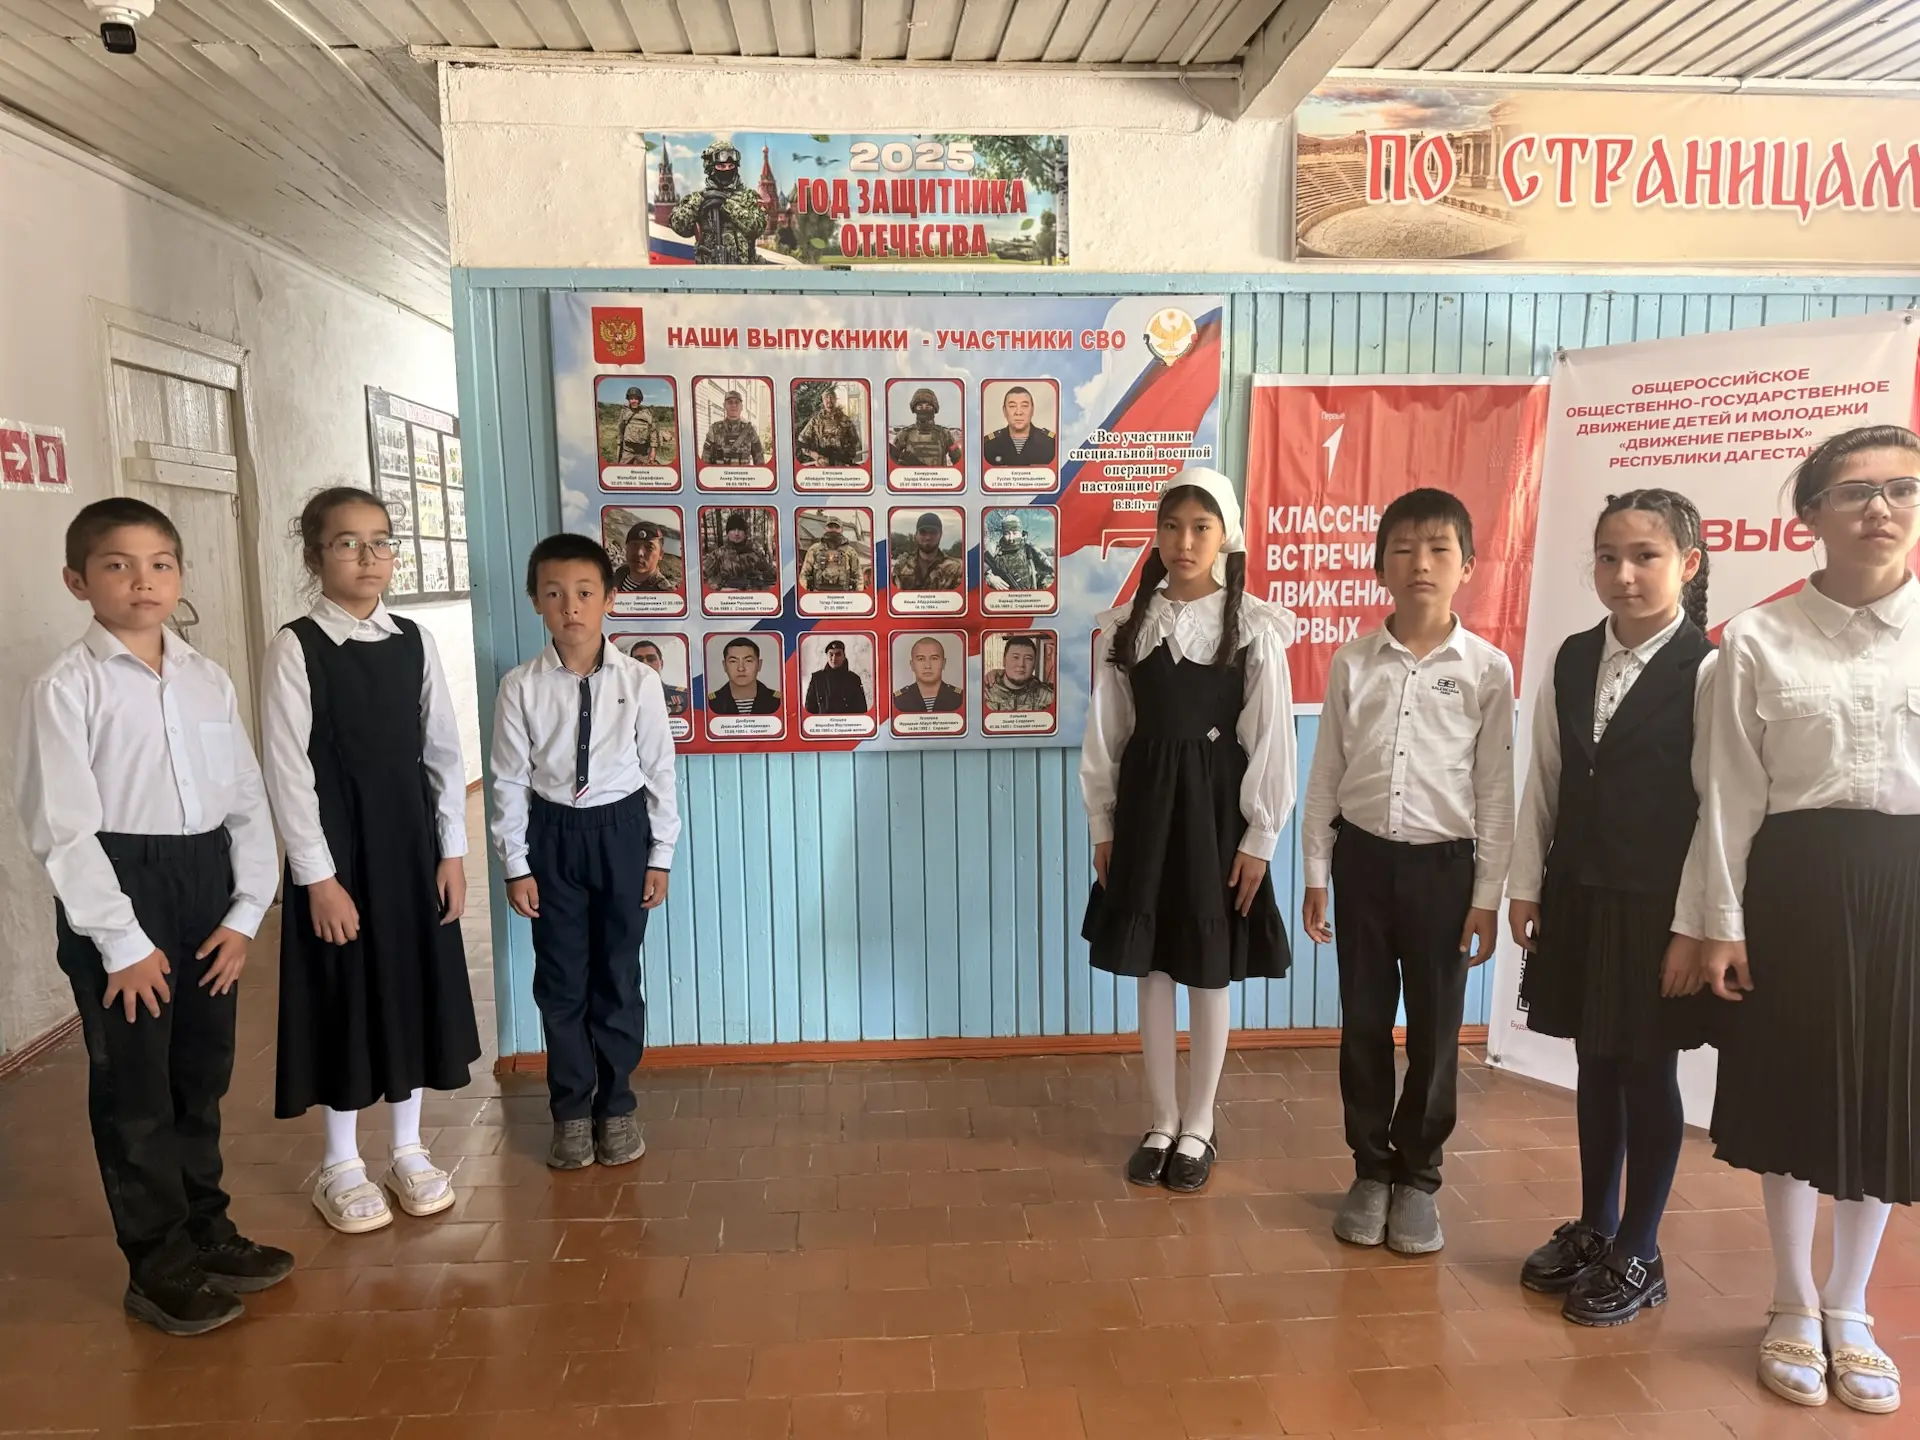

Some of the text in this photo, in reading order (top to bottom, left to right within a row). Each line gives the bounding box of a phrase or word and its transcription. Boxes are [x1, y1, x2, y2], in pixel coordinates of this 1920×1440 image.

[849, 141, 975, 172] 2025
[1368, 133, 1920, 222] ПО СТРАНИЦАМ
[798, 178, 1027, 219] ГОД ЗАЩИТНИКА
[841, 223, 989, 258] ОТЕЧЕСТВА
[667, 327, 739, 348] НАШИ
[747, 328, 908, 350] ВЫПУСКНИКИ
[937, 329, 1073, 350] УЧАСТНИКИ
[1080, 329, 1127, 350] СВО
[1631, 368, 1810, 395] ОБЩЕРОССИЙСКОЕ
[1566, 380, 1890, 419] ОБЩЕСТВЕННО-ГОСУДАРСТВЕННОЕ
[1321, 411, 1345, 420] Первые
[1576, 402, 1869, 436] ДВИЖЕНИЕ ДЕТЕЙ И МОЛОДЕЖИ
[1089, 431, 1192, 445] «Все участники
[1619, 426, 1812, 451] «ДВИЖЕНИЕ ПЕРВЫХ»
[1070, 446, 1211, 460] специальной военной
[1609, 451, 1721, 468] РЕСПУБЛИКИ
[1104, 465, 1166, 478] операции
[1081, 482, 1151, 492] настоящие
[1115, 500, 1158, 511] В.В.Пути
[1268, 505, 1389, 534] КЛАССНЫ
[1267, 543, 1376, 571] ВСТРЕЧИ
[1296, 616, 1361, 644] РВЫХ
